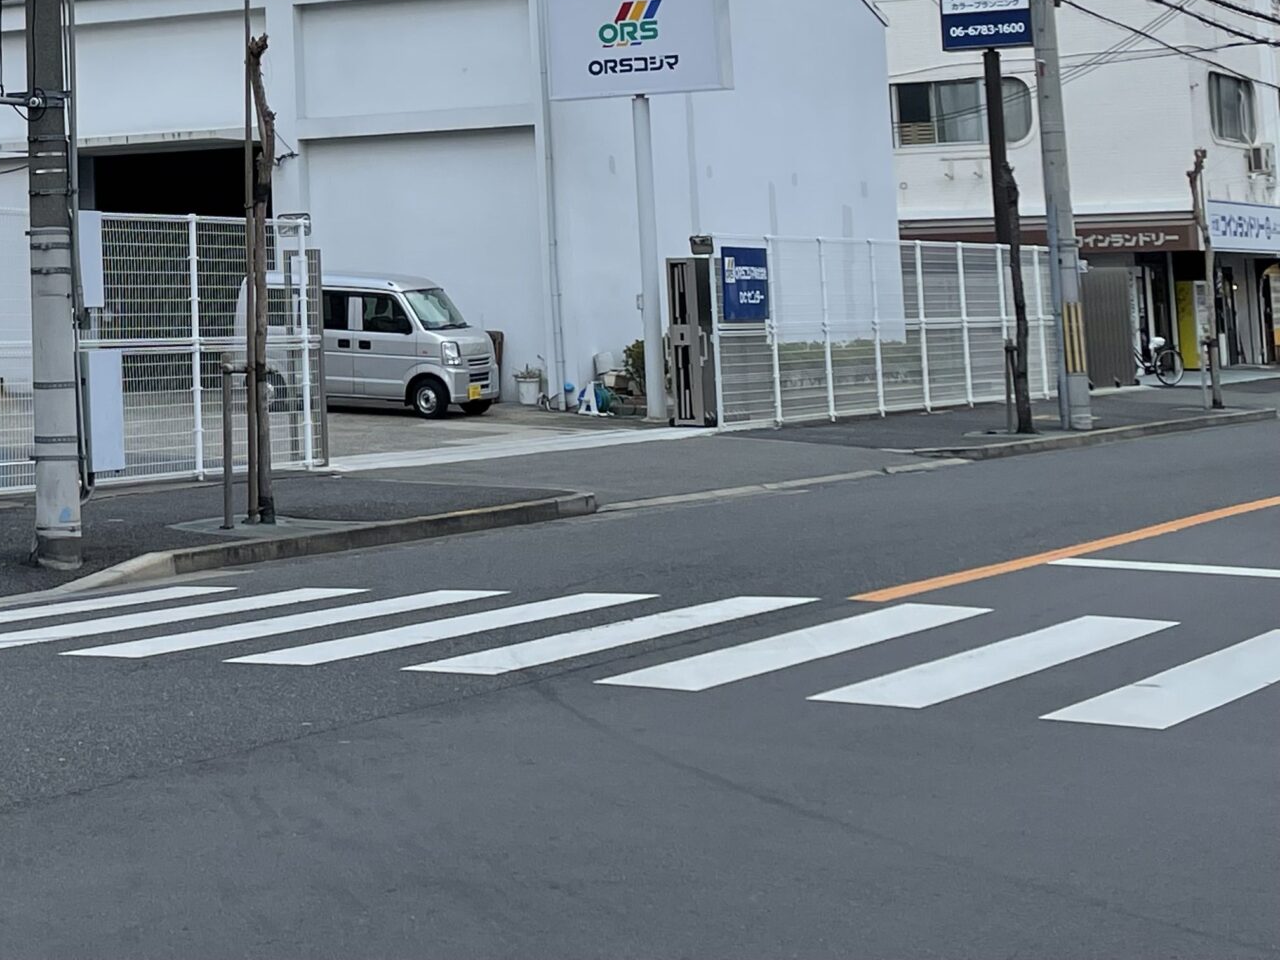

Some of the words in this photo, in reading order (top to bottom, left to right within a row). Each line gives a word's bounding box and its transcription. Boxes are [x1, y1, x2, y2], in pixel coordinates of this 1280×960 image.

[598, 20, 659, 44] ORS
[949, 22, 1026, 38] 06-6783-1600
[588, 54, 679, 76] ORSコジマ
